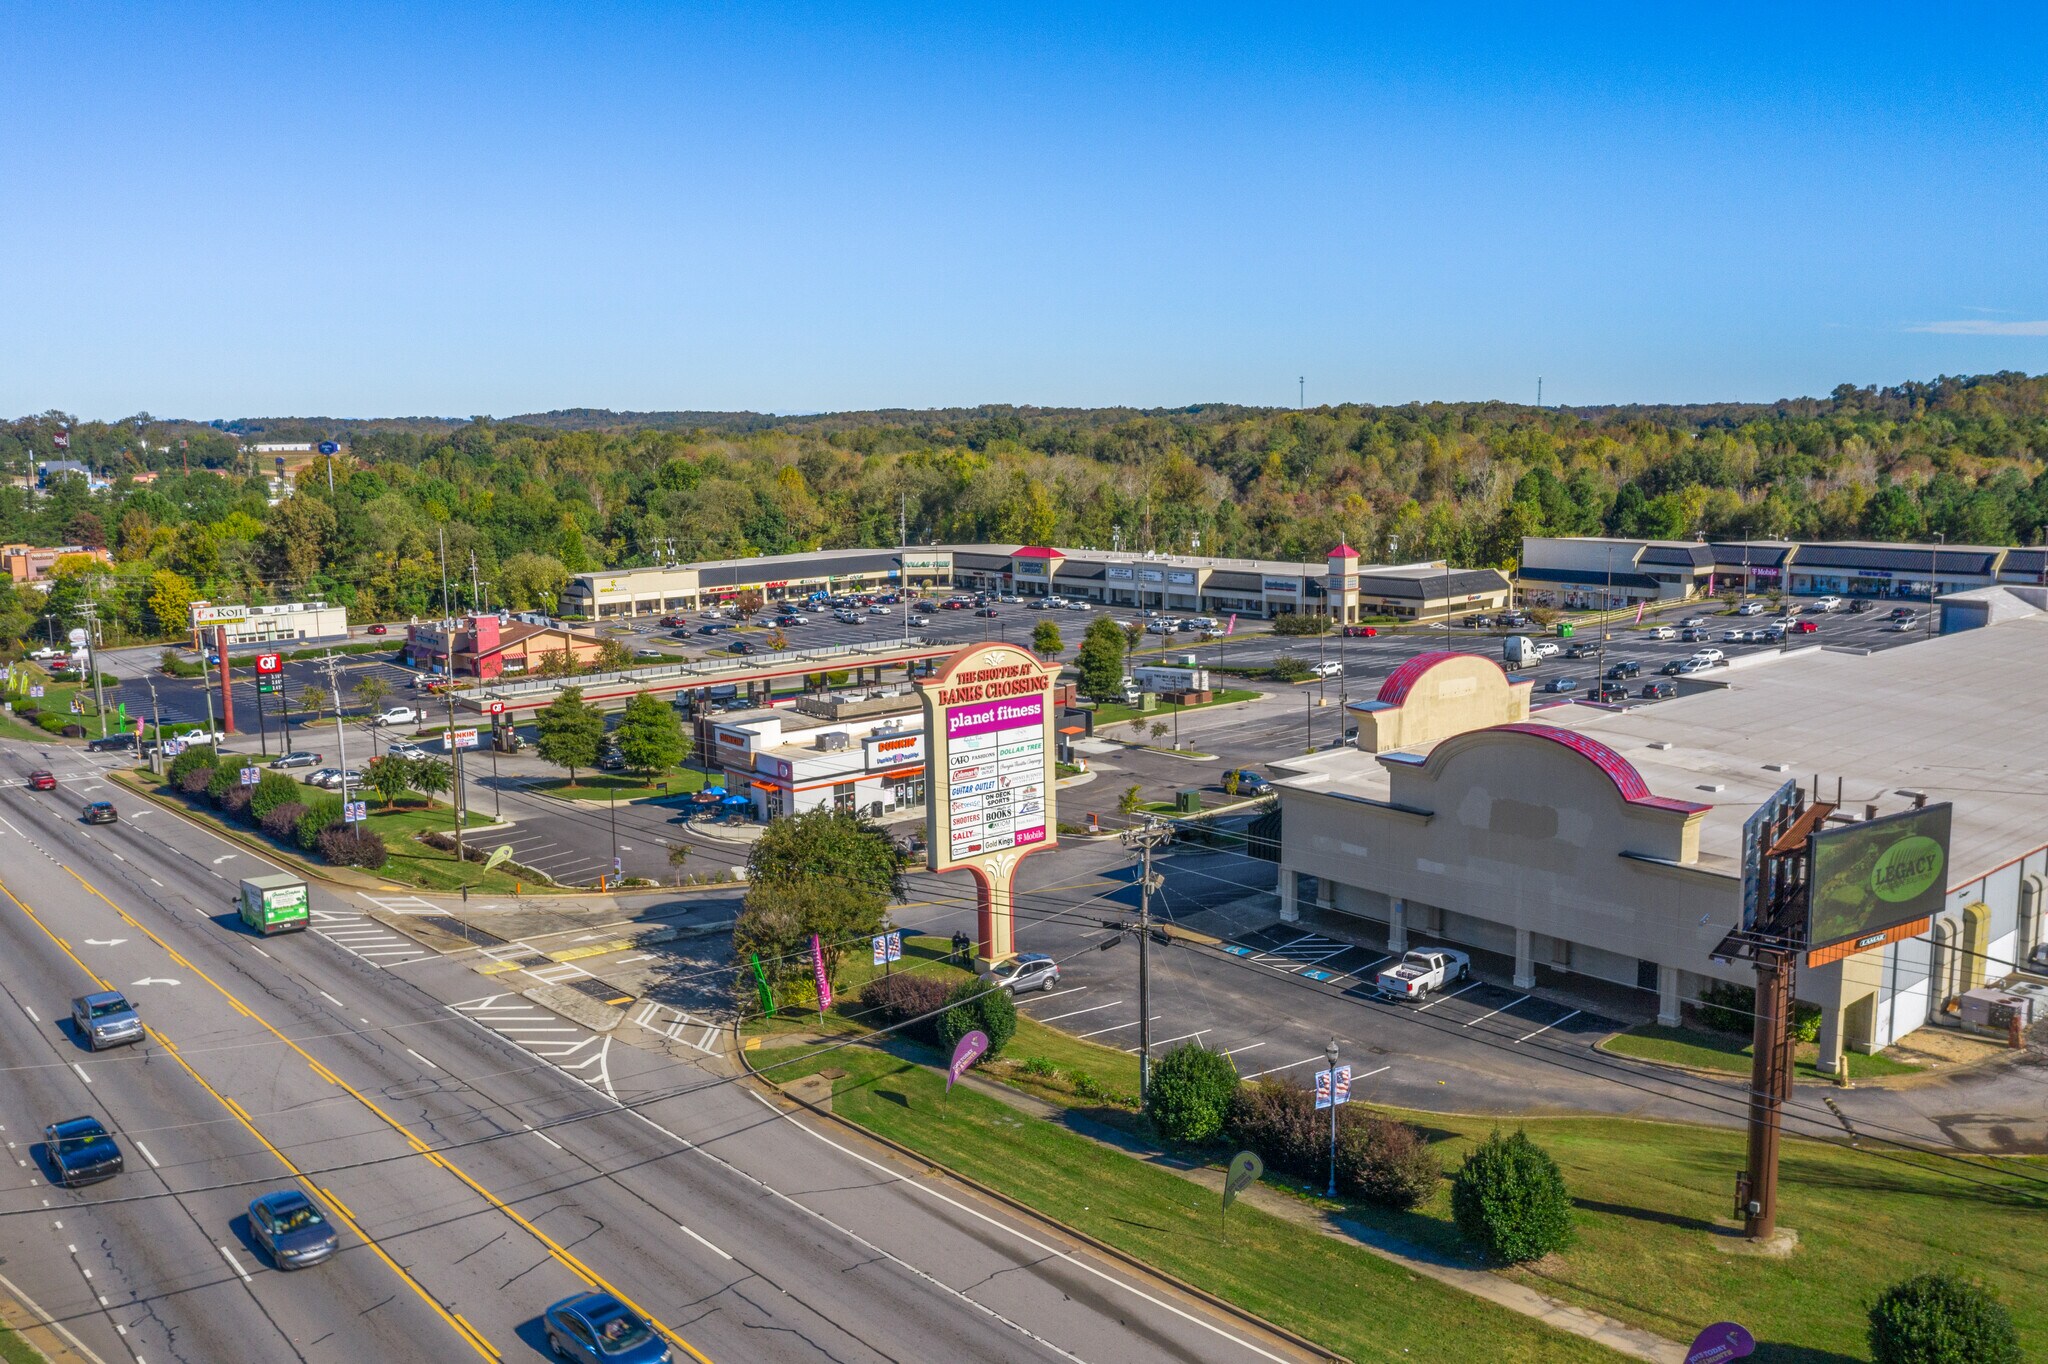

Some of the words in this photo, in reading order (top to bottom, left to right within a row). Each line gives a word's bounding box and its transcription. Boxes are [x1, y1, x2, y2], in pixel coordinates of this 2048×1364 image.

[1758, 568, 1778, 576] Mobile
[260, 657, 277, 669] QT
[956, 671, 976, 685] THE
[977, 665, 1019, 682] SHOPPES
[1019, 663, 1032, 676] AT
[938, 685, 983, 706] BANKS
[986, 675, 1049, 698] CROSSING
[950, 709, 995, 732] planet
[997, 704, 1041, 720] fitness
[878, 737, 917, 752] DUNKIN'
[1000, 746, 1025, 756] DOLLAR
[1027, 743, 1042, 751] TREE
[951, 755, 970, 765] CATO
[952, 785, 973, 796] GUITAR
[975, 781, 995, 791] OUTLET
[988, 797, 1010, 806] SPORTS
[953, 814, 980, 826] SHOOTERS
[986, 810, 1011, 821] BOOKS
[953, 830, 973, 841] SALLY
[1023, 830, 1044, 841] Mobile
[985, 840, 997, 849] Gold
[998, 838, 1013, 846] Kings
[1876, 854, 1936, 886] LEGACY
[1703, 1344, 1727, 1357] TODAY
